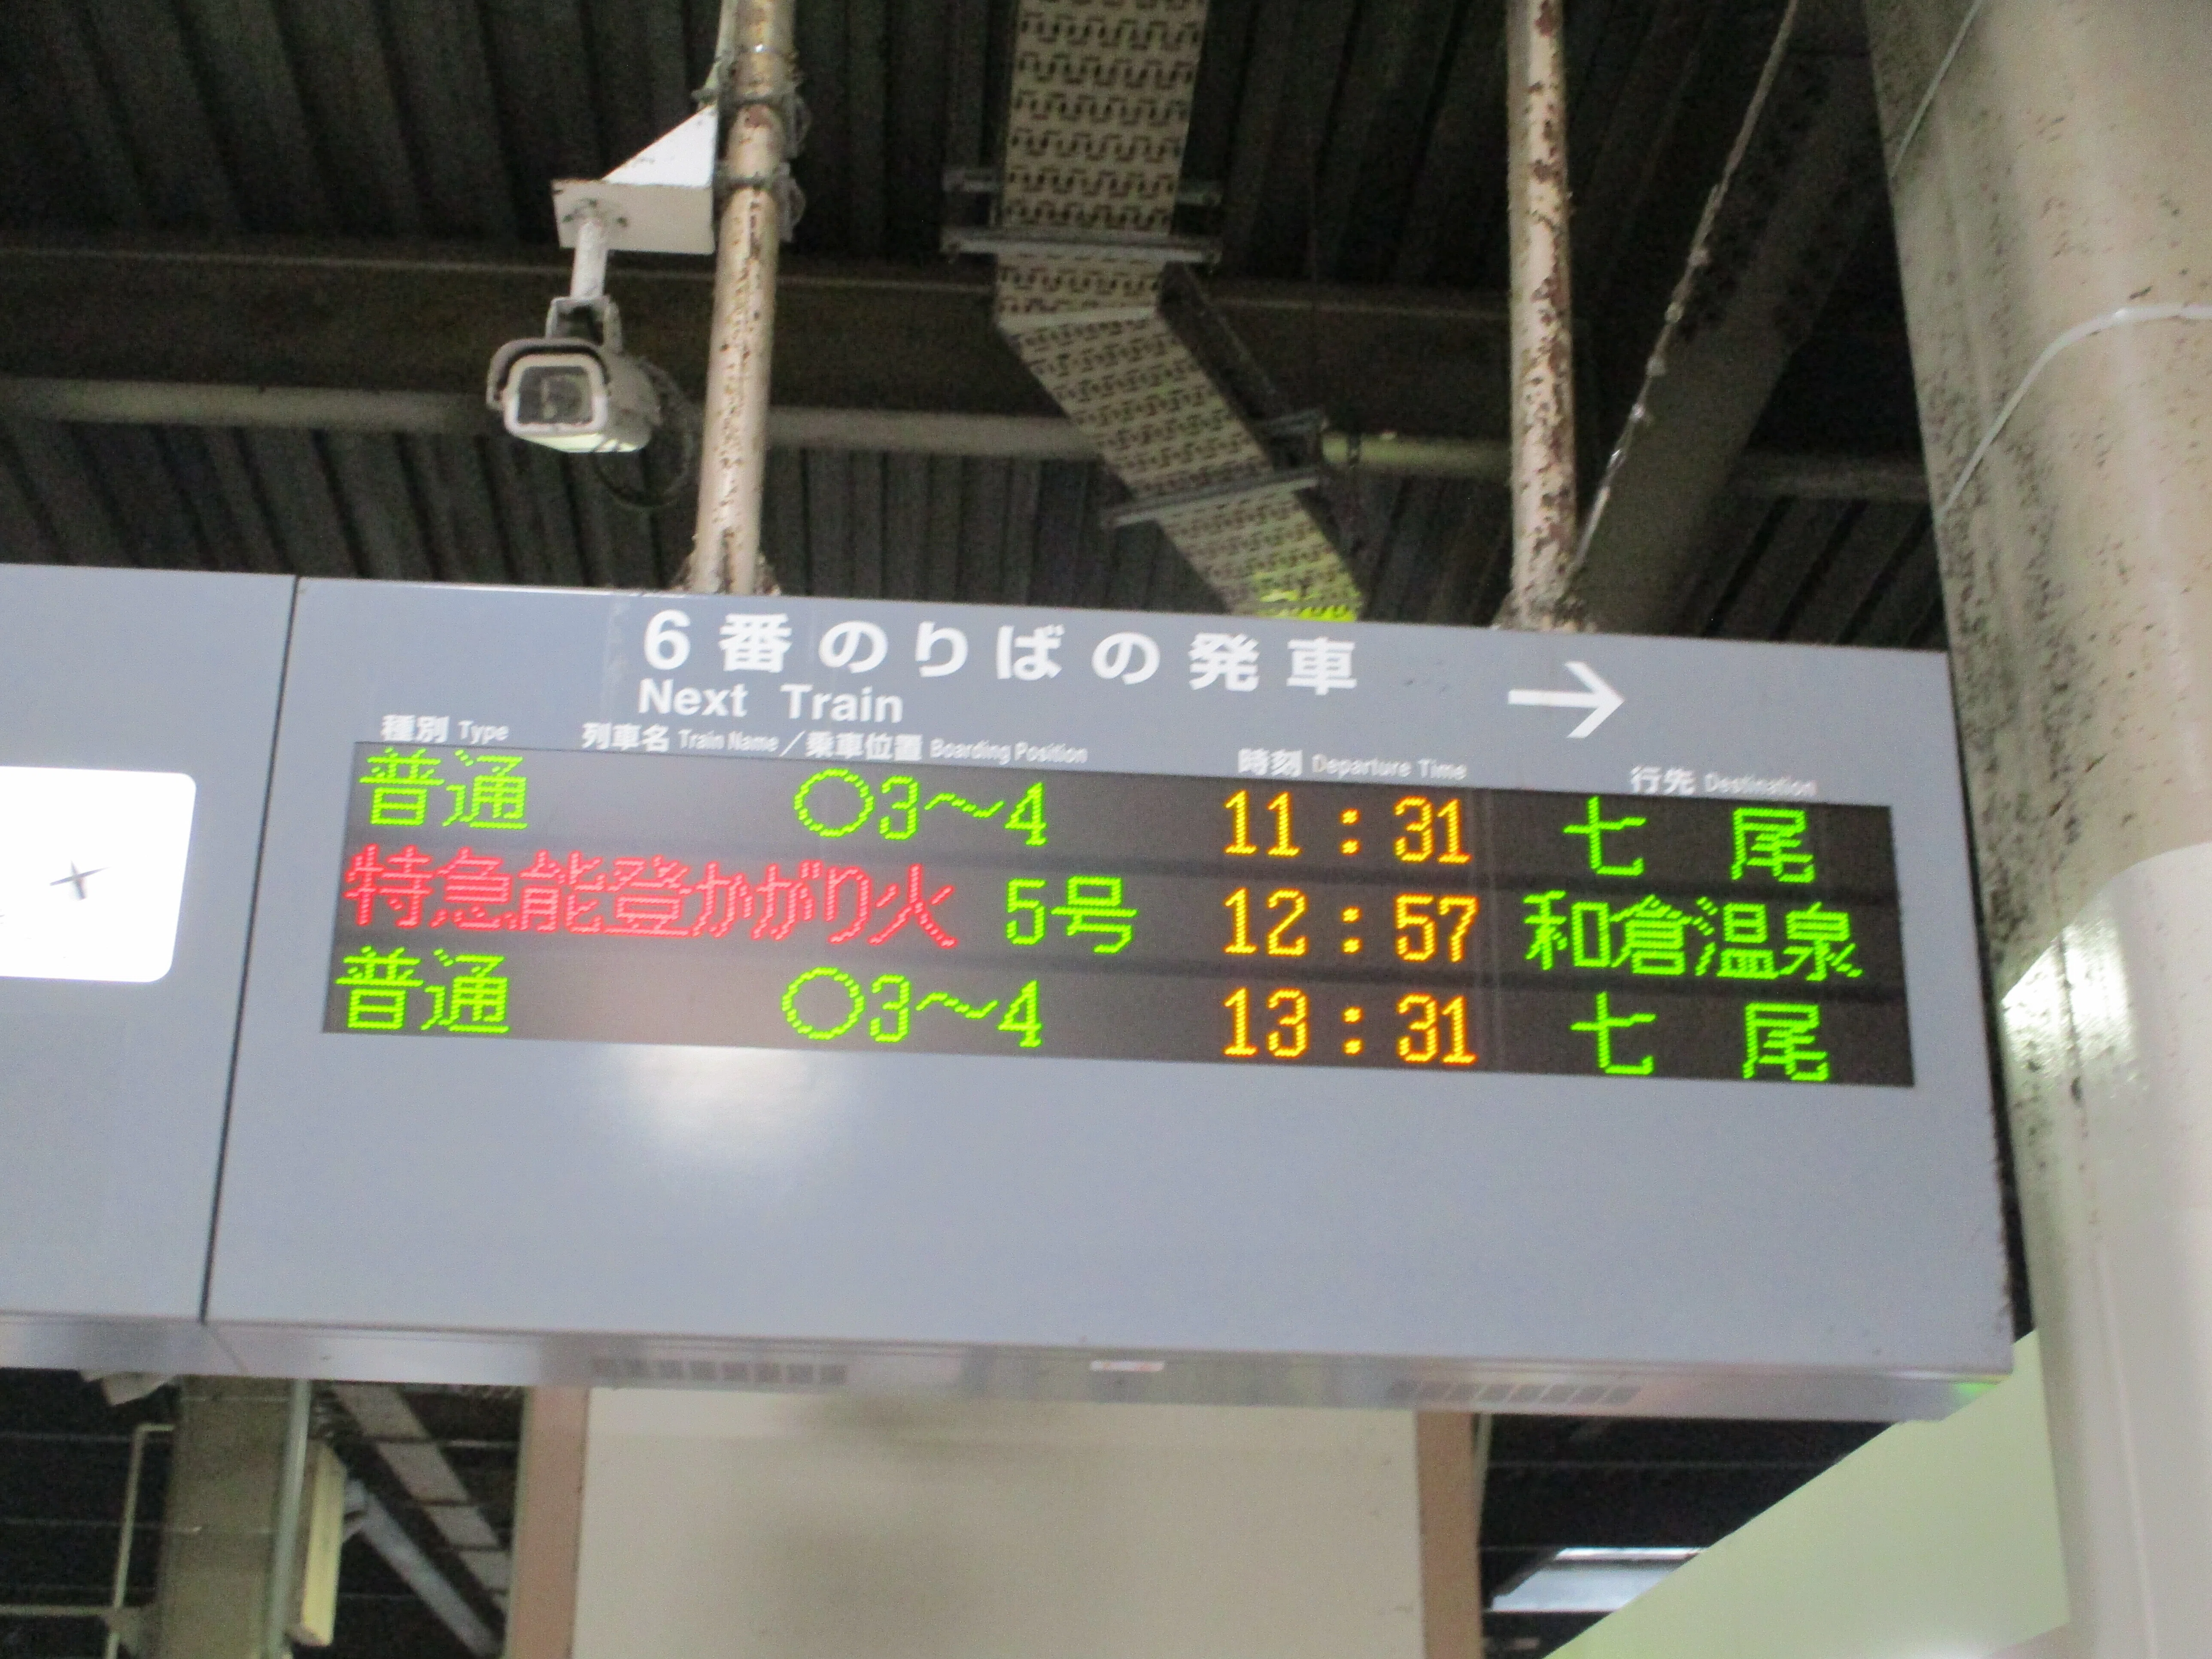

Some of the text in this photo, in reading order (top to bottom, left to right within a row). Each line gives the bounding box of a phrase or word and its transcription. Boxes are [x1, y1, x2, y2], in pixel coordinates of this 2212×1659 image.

[638, 678, 903, 723] Next Train
[381, 714, 509, 744] 種別 Type
[582, 722, 669, 752] 列車名
[678, 727, 724, 750] Train
[728, 730, 779, 753] Name
[930, 738, 1010, 765] Boarding
[1015, 741, 1088, 764] Position
[1238, 748, 1467, 780] 時刻 Departure Time
[1630, 765, 1696, 796] 行先
[358, 747, 528, 830] 普通
[1522, 889, 1864, 982] 和倉温泉
[334, 944, 511, 1034] 普通
